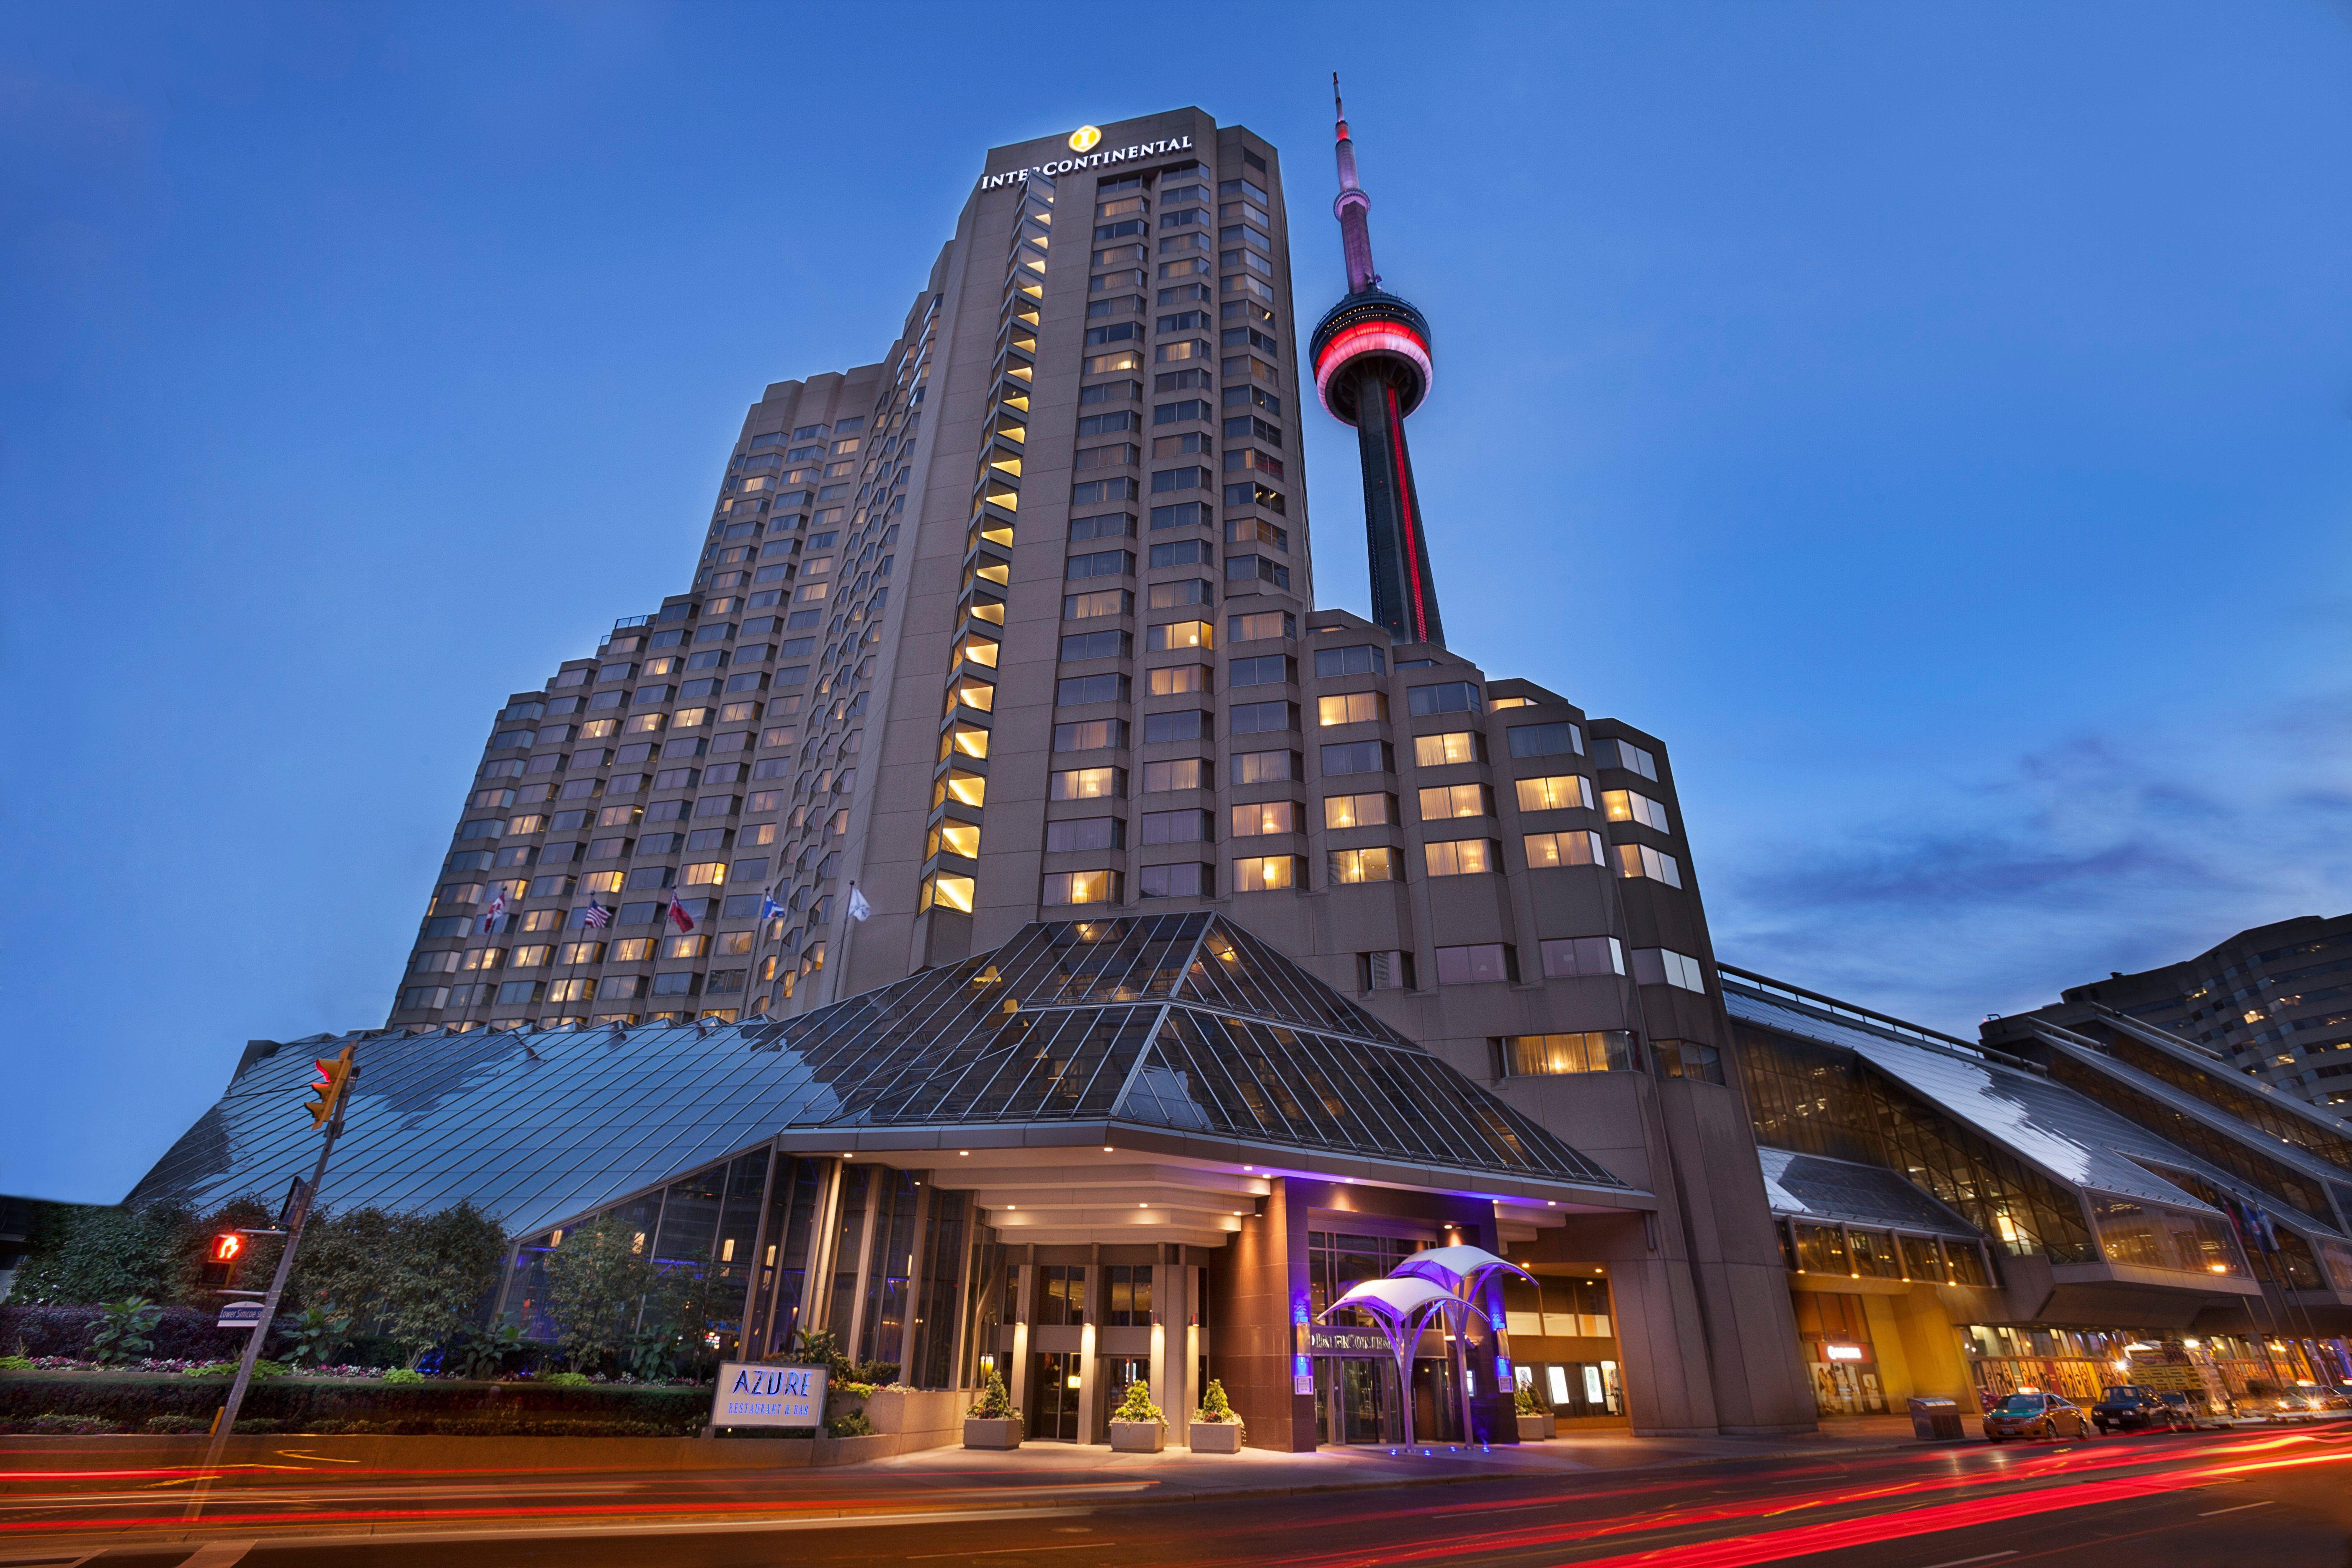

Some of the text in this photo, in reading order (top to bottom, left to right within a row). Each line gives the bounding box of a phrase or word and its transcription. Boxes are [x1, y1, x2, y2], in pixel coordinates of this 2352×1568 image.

[219, 1309, 236, 1318] Lower
[236, 1309, 256, 1318] Simcoe
[733, 1370, 812, 1396] AZURE
[728, 1403, 809, 1416] RESTAURANT & BAR
